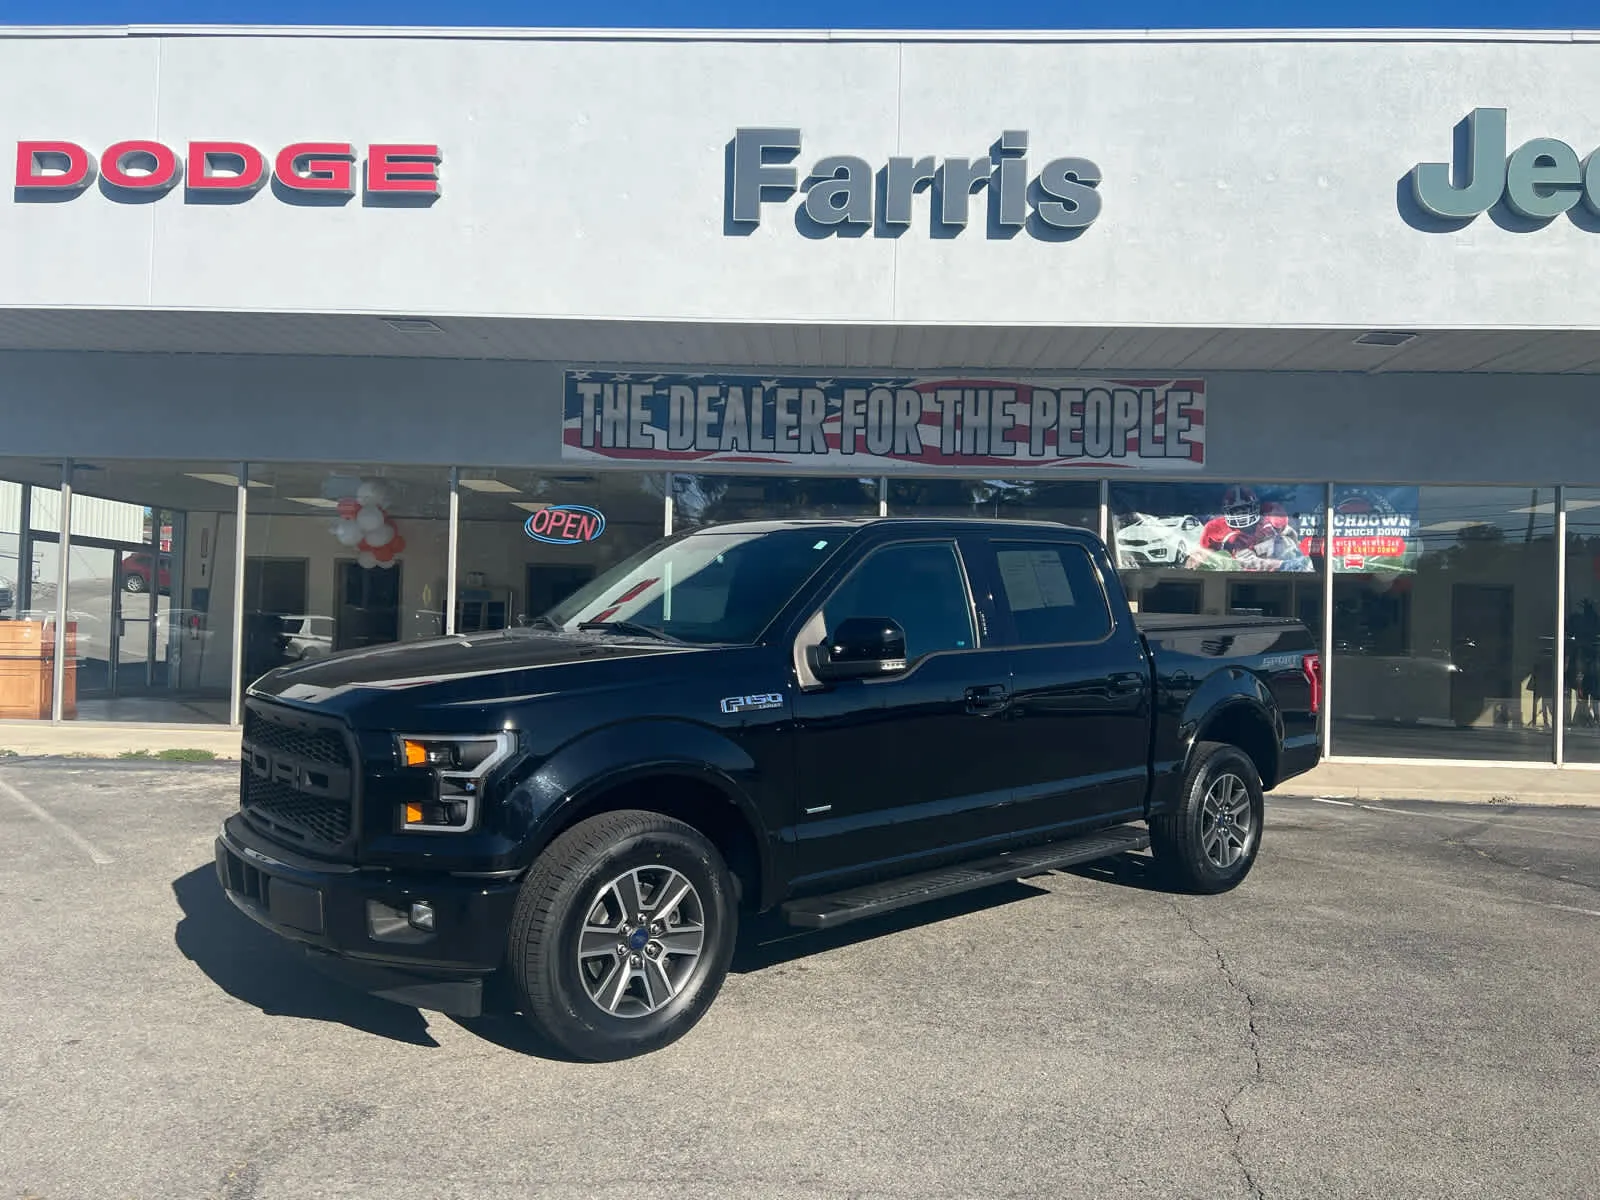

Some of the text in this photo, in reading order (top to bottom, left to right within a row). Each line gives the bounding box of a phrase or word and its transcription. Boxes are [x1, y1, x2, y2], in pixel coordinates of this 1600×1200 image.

[15, 140, 441, 195] DODGE
[731, 127, 1103, 229] Farris
[1417, 107, 1600, 218] Je
[576, 382, 1193, 458] THE DEALER FOR THE PEOPLE
[531, 508, 597, 541] OPEN
[1299, 513, 1411, 528] TOCHDOWN
[1344, 527, 1374, 537] MUCH
[1376, 527, 1411, 537] DOWN!
